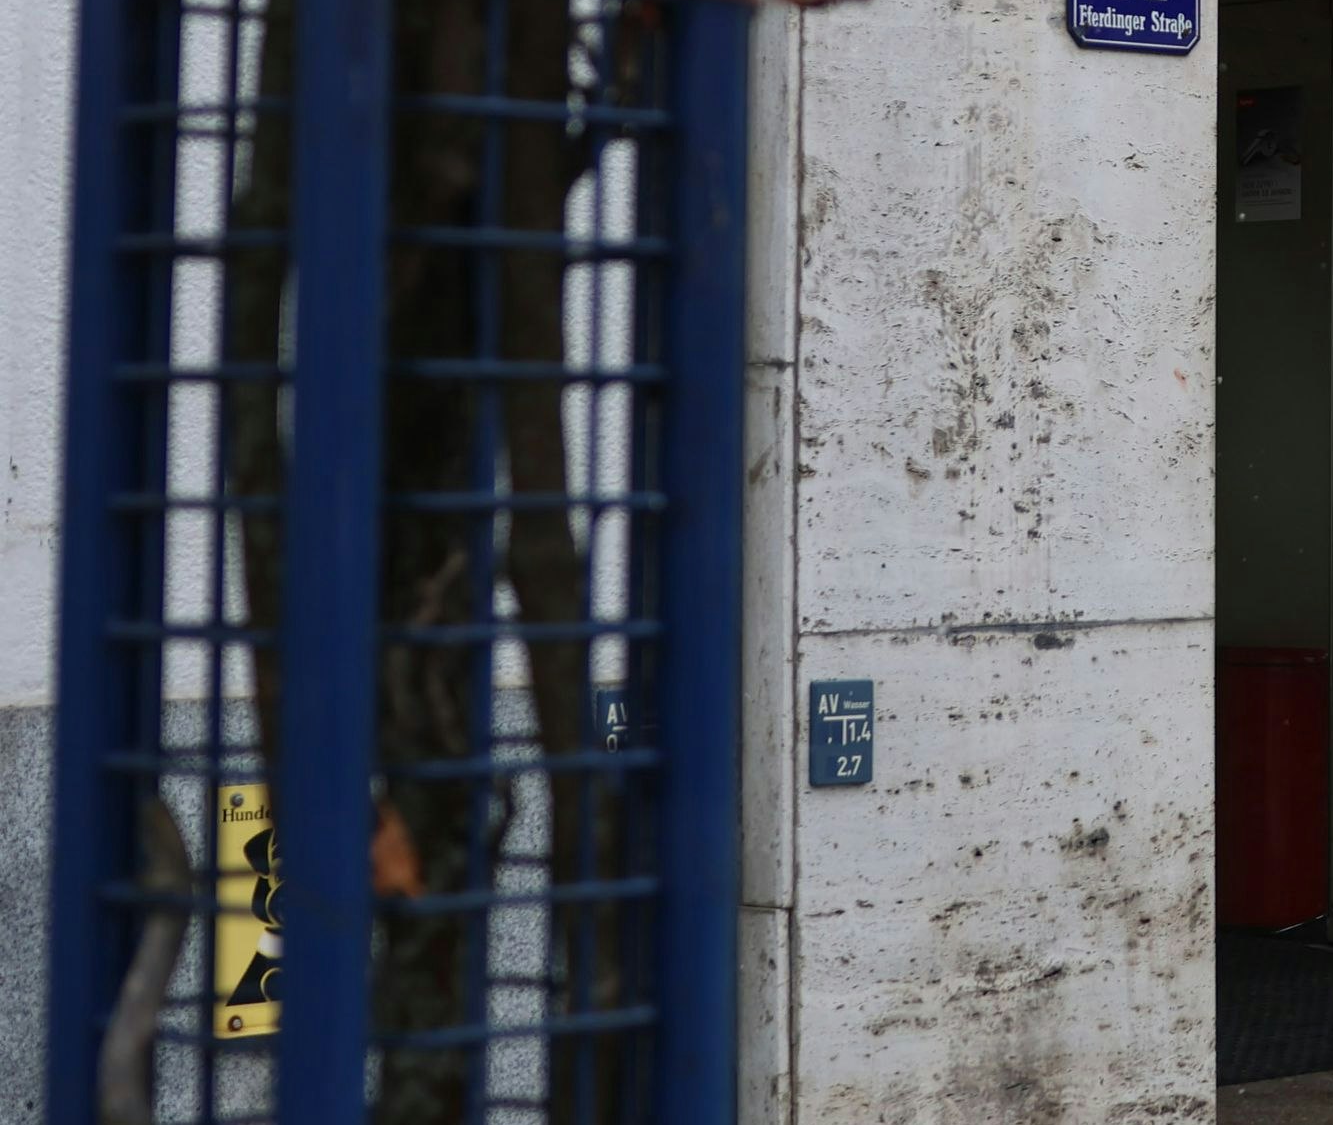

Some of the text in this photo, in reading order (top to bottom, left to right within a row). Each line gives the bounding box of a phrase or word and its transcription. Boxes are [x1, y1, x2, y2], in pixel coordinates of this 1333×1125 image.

[1151, 10, 1192, 39] Straße
[819, 693, 840, 714] AV
[837, 755, 862, 776] 2,7
